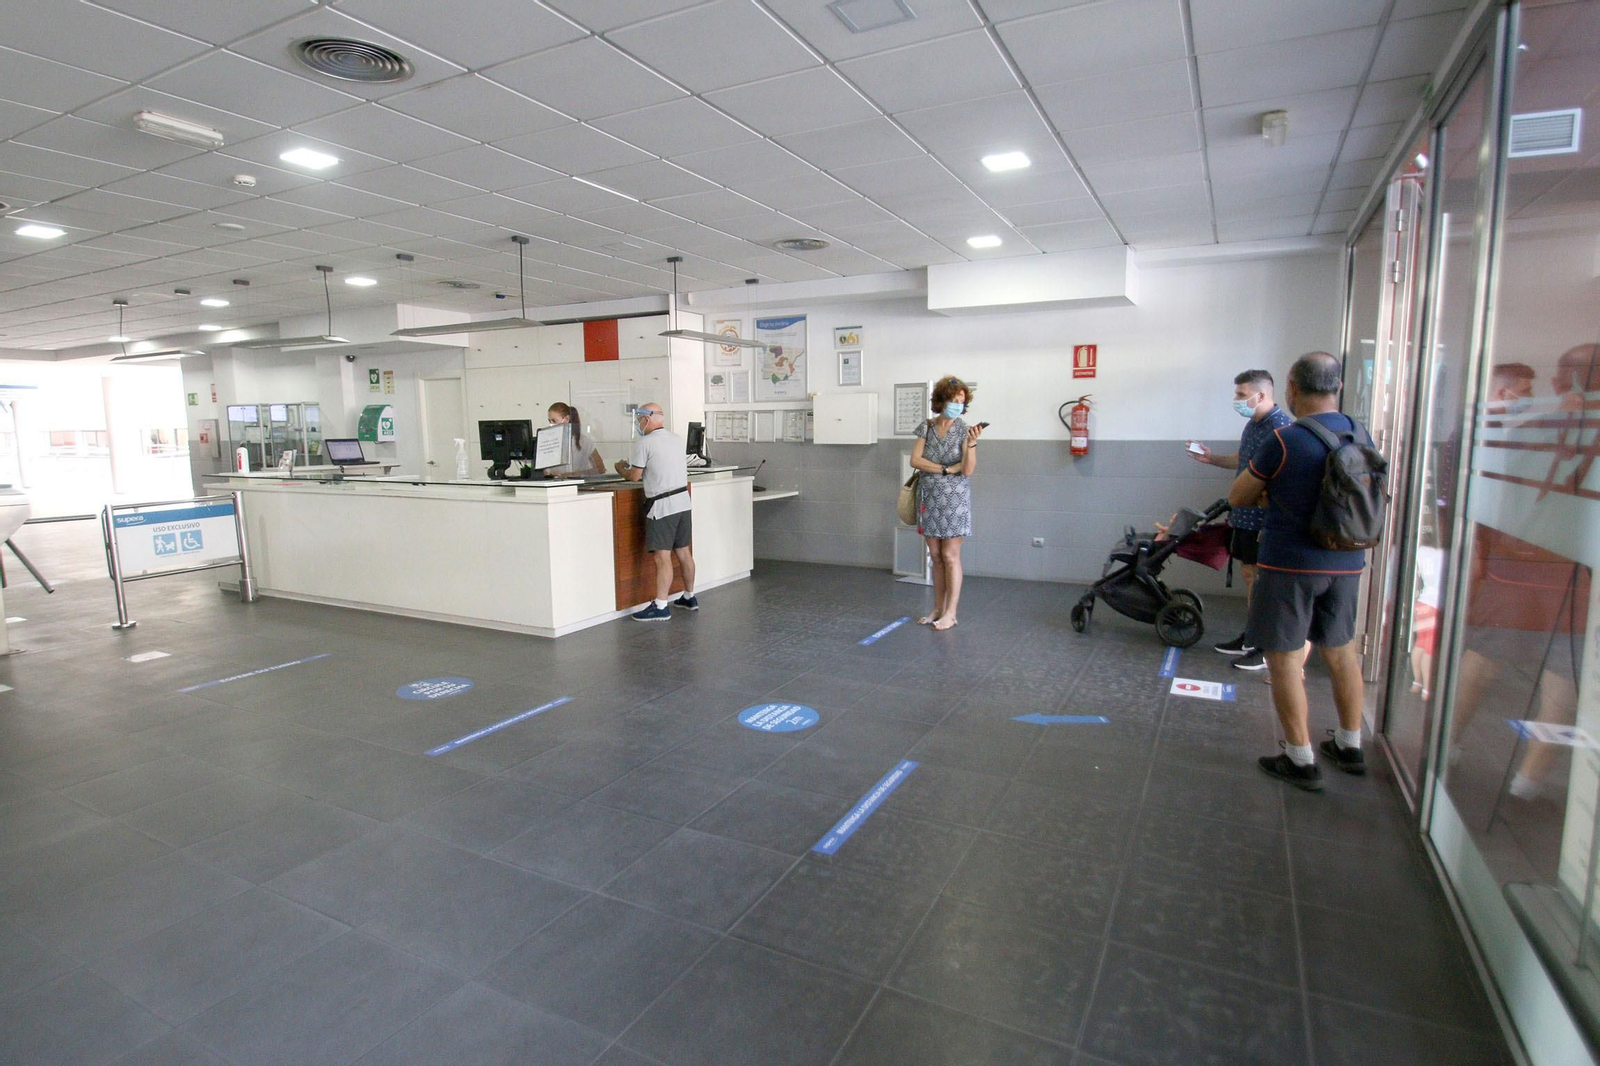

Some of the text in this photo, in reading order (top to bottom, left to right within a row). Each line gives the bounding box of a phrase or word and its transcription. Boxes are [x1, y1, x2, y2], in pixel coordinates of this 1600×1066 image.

[117, 515, 145, 524] supera
[167, 522, 201, 531] EXCLUSIVO
[745, 704, 778, 723] MANTENGA
[761, 705, 791, 722] DISTANCIA
[770, 706, 802, 725] SEGURIDAD
